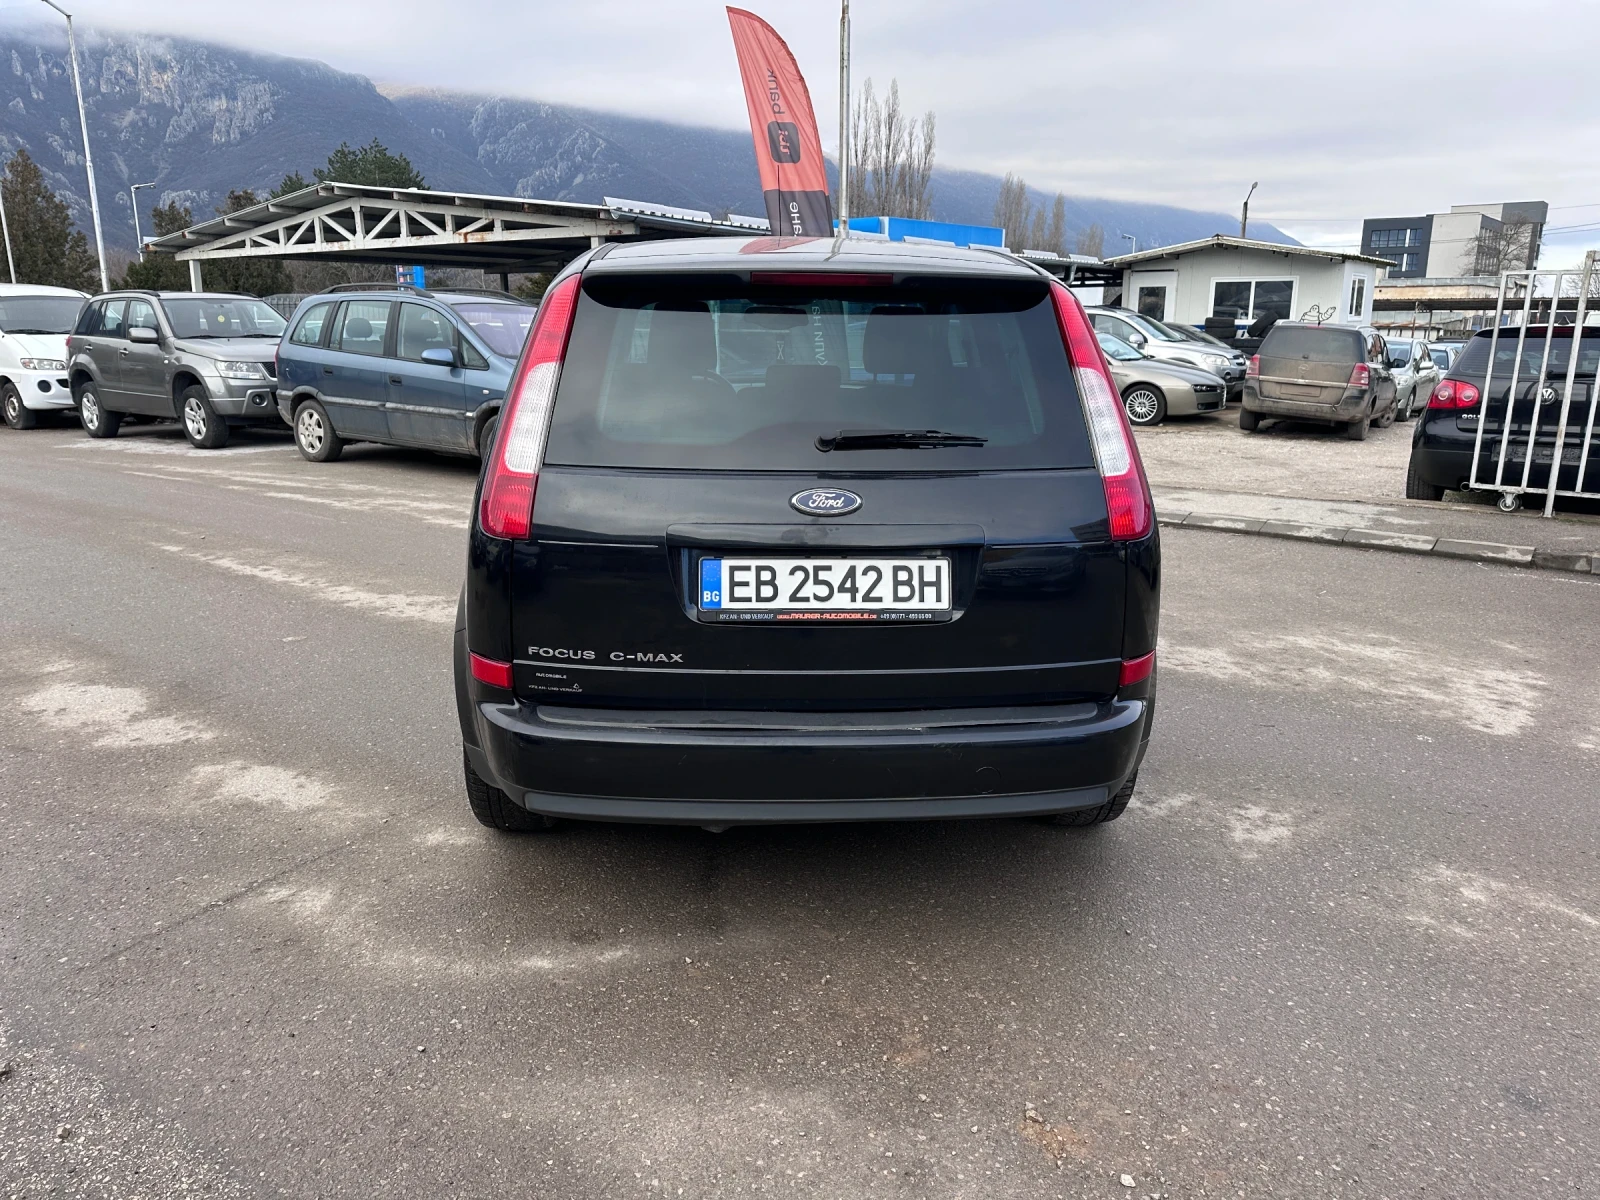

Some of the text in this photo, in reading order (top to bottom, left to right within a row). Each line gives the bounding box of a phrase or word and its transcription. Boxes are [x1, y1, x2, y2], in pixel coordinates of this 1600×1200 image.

[808, 492, 845, 508] Ford
[728, 565, 942, 603] EB 2542 BH
[703, 591, 720, 602] BG
[528, 646, 684, 663] FOCUS C-MAX
